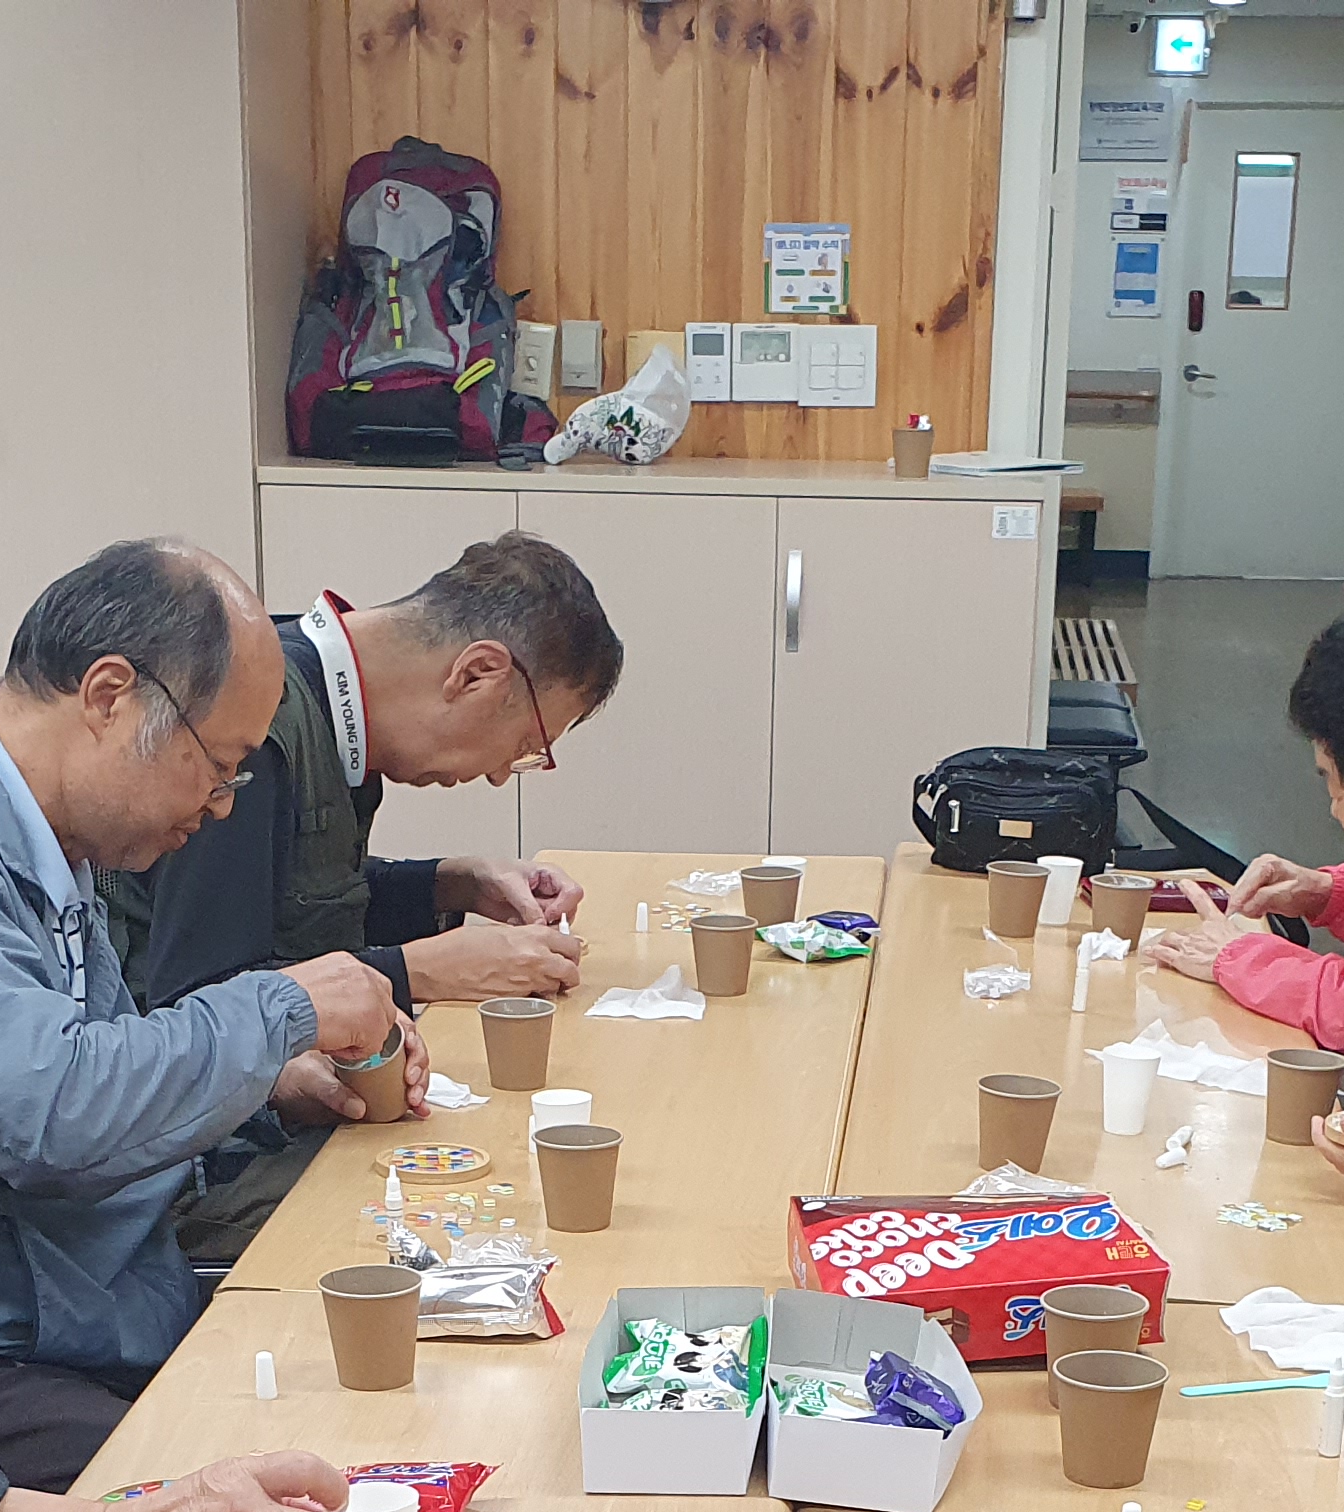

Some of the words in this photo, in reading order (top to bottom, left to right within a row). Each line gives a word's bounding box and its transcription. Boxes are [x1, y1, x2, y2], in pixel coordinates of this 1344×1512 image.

[336, 670, 349, 698] KIM
[341, 698, 358, 744] YOUNG
[952, 1201, 1120, 1252] 오예스
[842, 1239, 976, 1298] Deep
[1106, 1244, 1151, 1261] 해태
